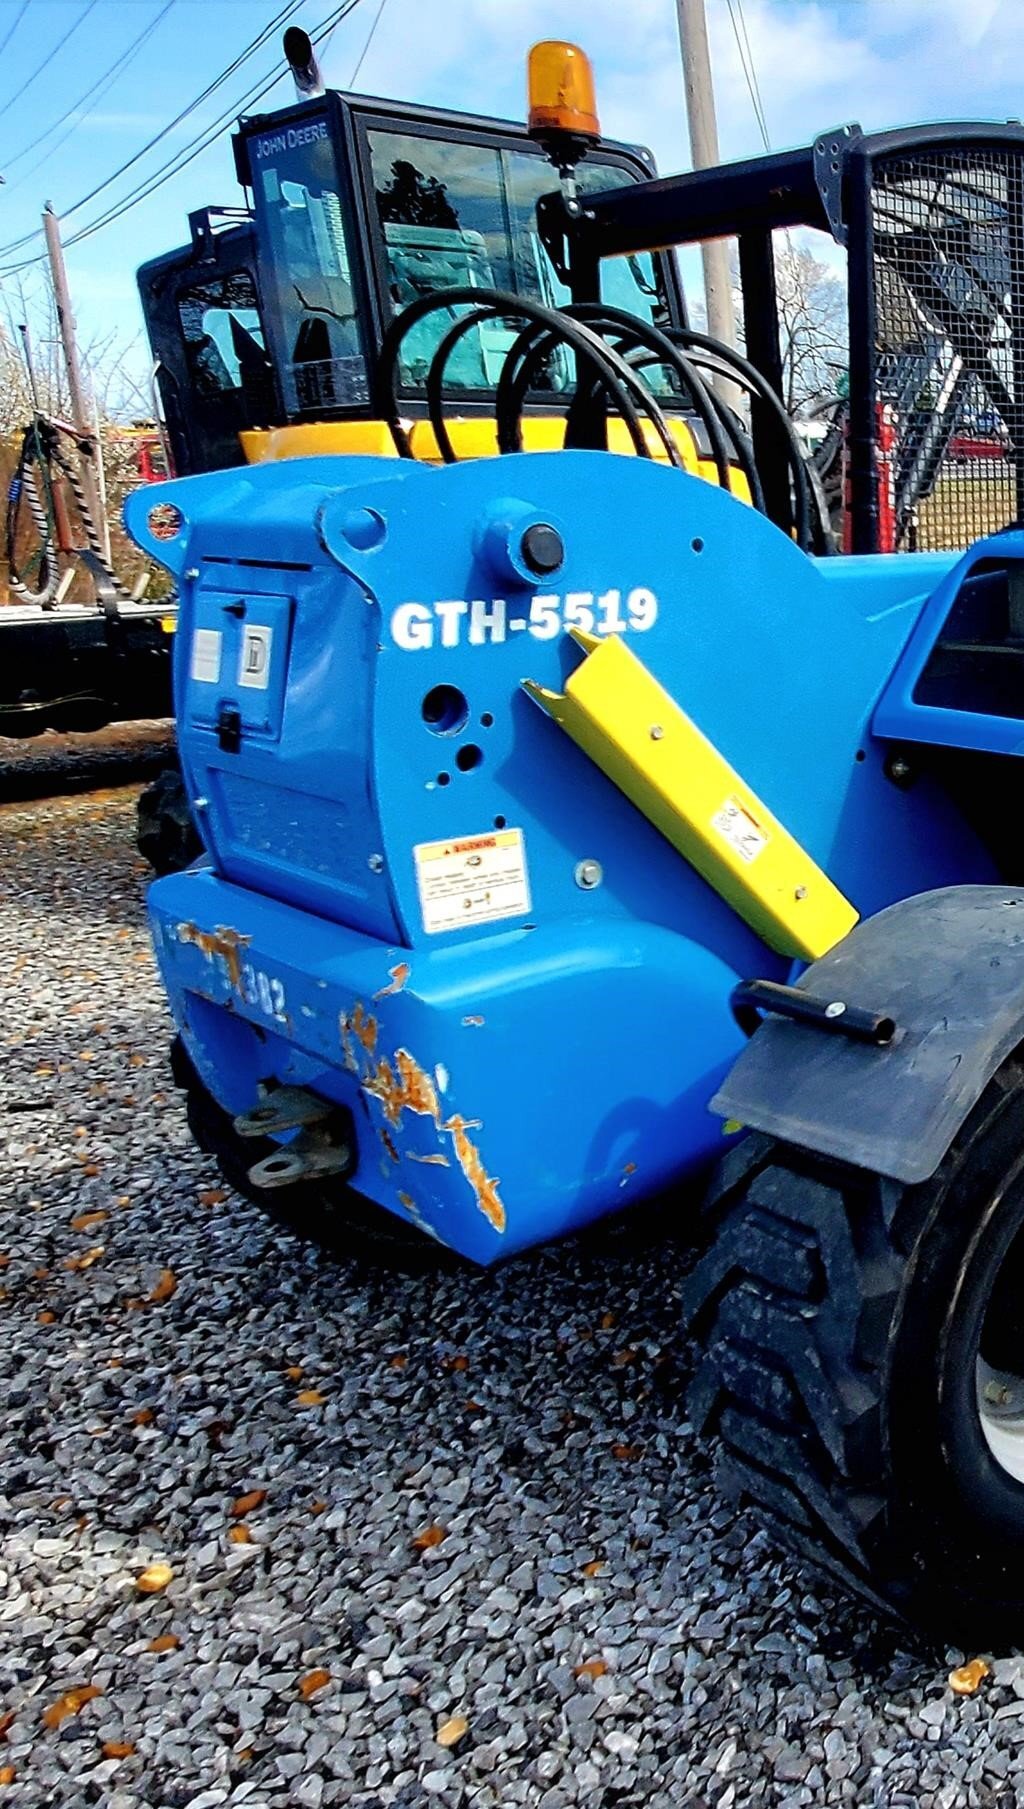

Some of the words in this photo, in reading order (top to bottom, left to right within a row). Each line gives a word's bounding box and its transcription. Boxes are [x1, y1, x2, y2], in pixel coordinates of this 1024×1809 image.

[256, 135, 287, 159] JOHN
[287, 122, 328, 148] DEERE
[390, 587, 659, 651] GTH-5519
